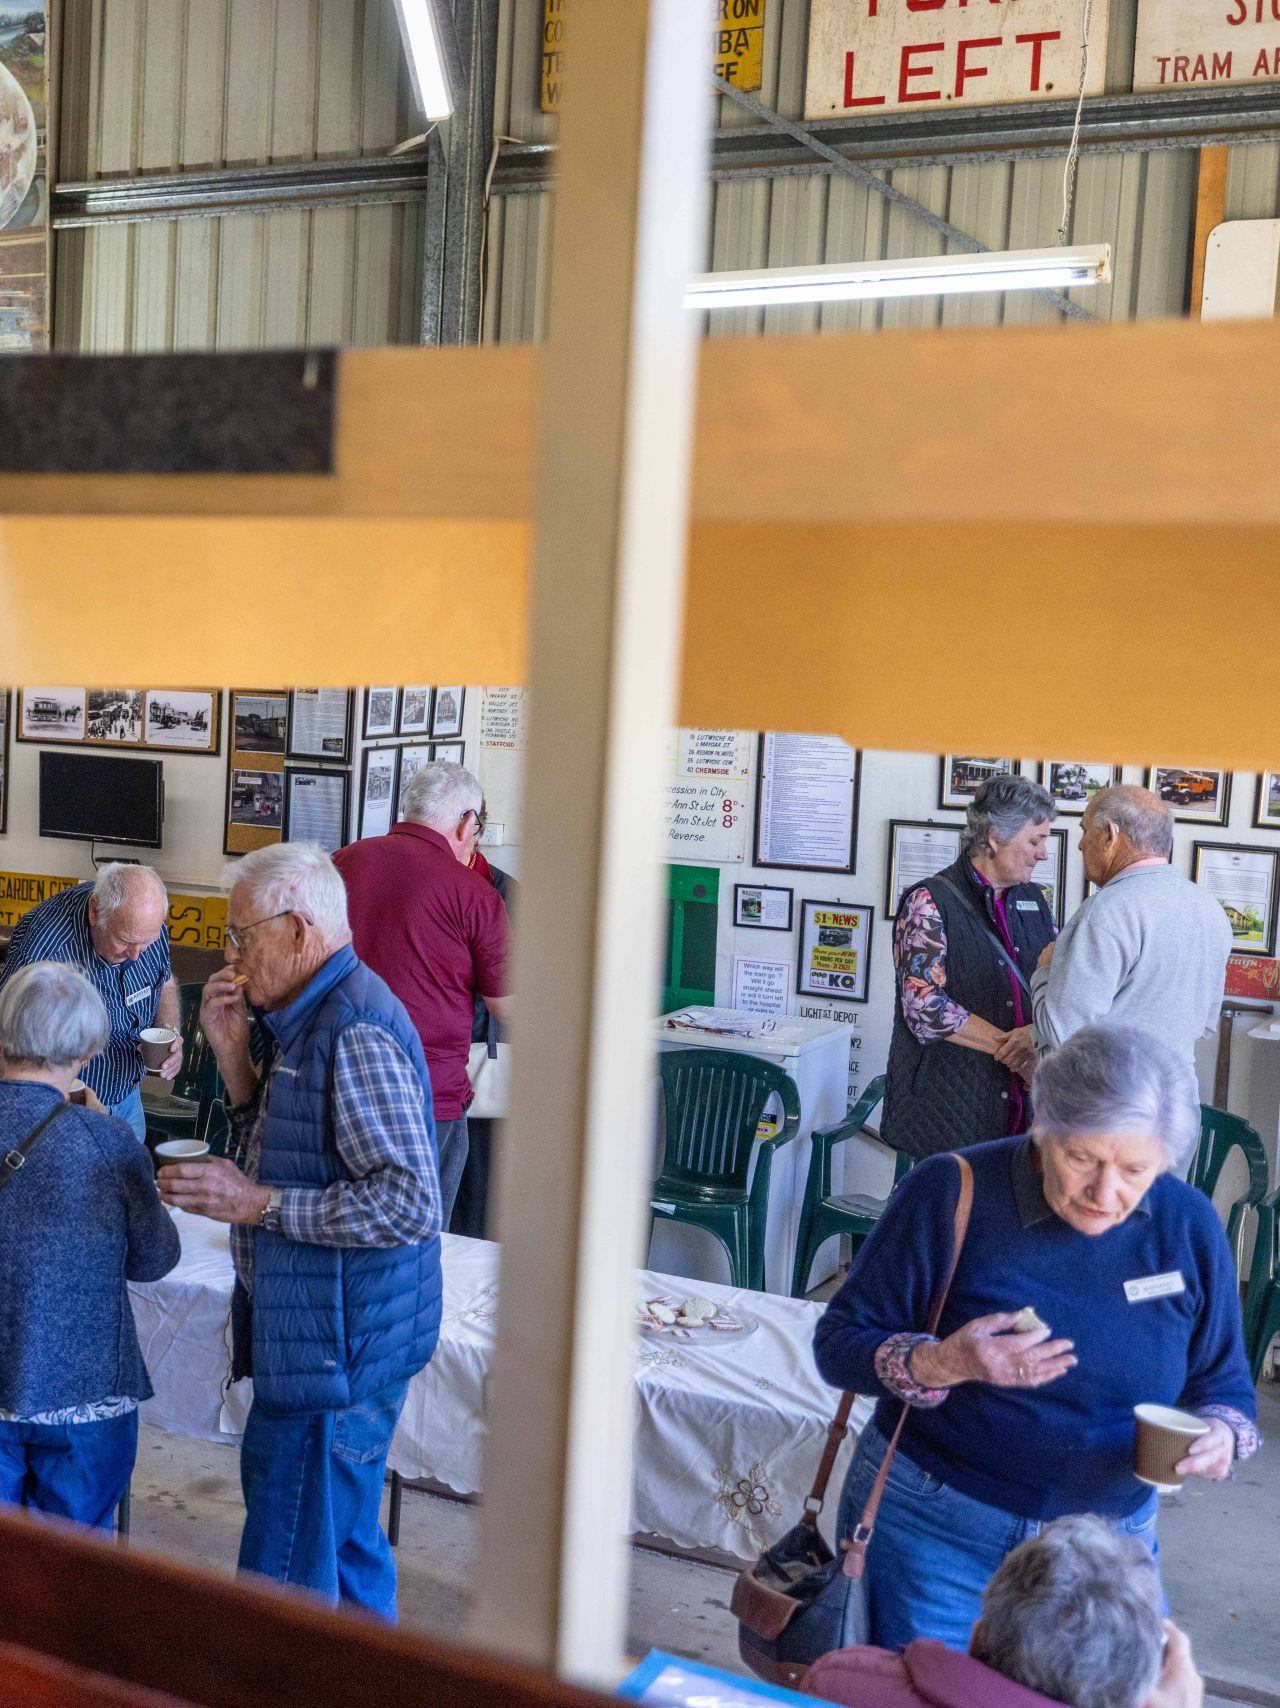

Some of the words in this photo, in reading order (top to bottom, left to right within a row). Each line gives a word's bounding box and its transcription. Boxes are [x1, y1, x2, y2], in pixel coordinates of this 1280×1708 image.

[844, 31, 1061, 108] LEFT
[1157, 51, 1232, 84] TRAM
[695, 767, 729, 775] CHERMSIDE
[699, 787, 707, 795] in
[671, 799, 688, 810] Ann
[689, 800, 699, 810] St
[673, 814, 689, 825] Ann
[690, 815, 701, 826] St
[832, 913, 858, 927] NEWS
[800, 1006, 822, 1019] LIGHT
[833, 1010, 858, 1024] DEPOT
